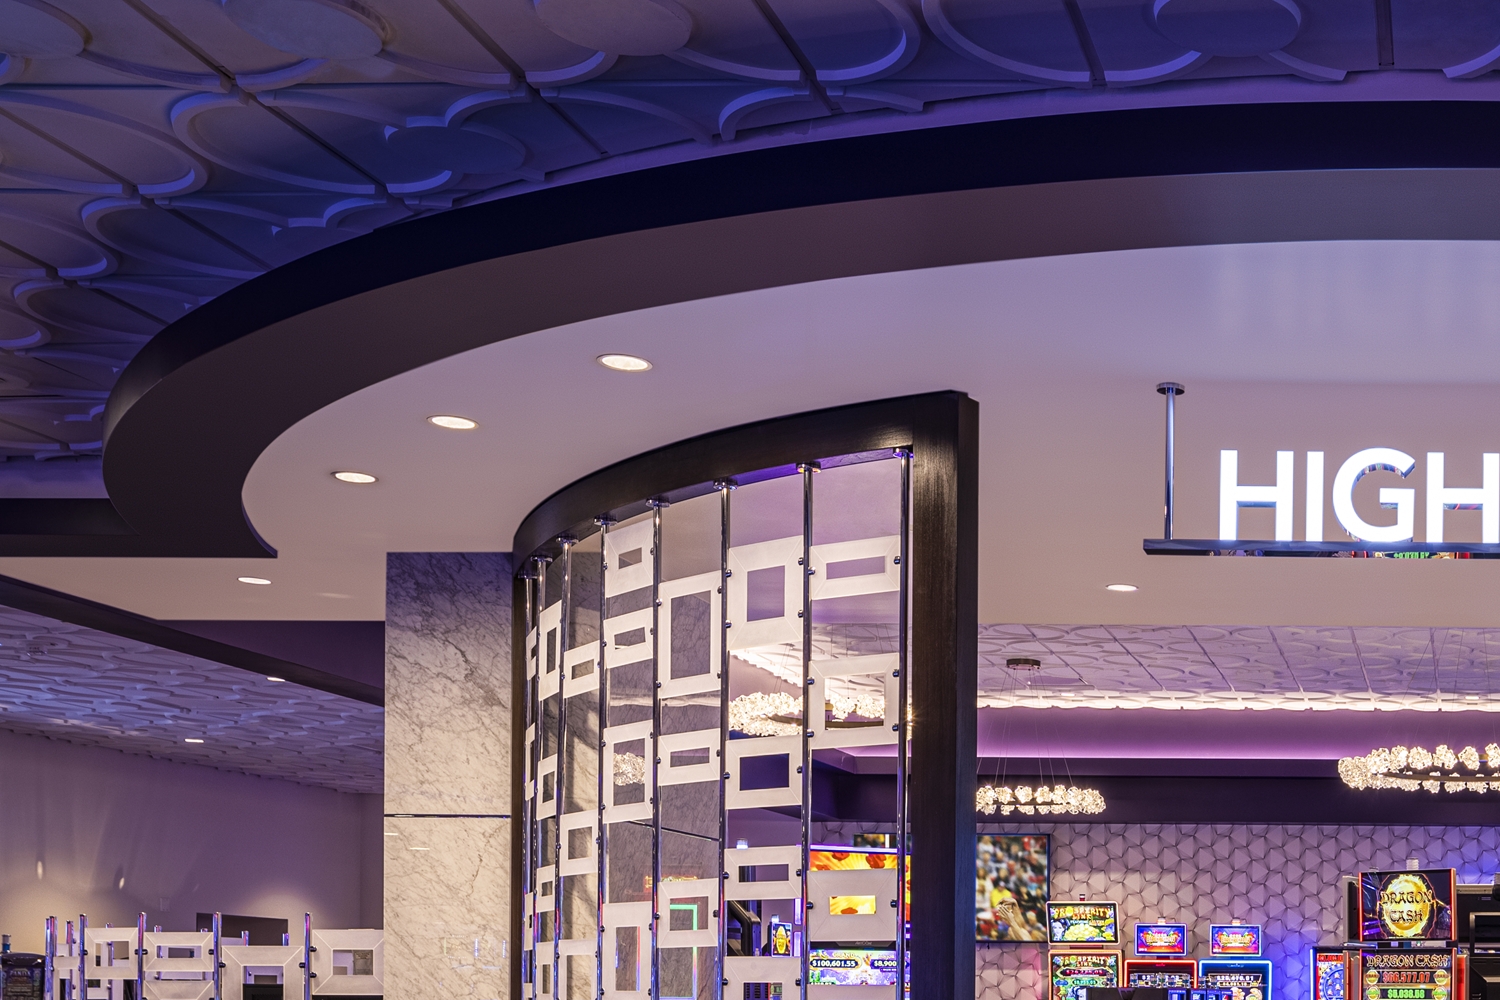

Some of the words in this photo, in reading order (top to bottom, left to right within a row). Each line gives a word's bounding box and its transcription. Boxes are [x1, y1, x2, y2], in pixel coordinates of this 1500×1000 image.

[1218, 447, 1500, 543] HIGH
[1380, 890, 1433, 904] DRAGON
[1390, 910, 1423, 922] CASH
[1366, 954, 1415, 967] DRAGON
[1415, 954, 1449, 967] CASH
